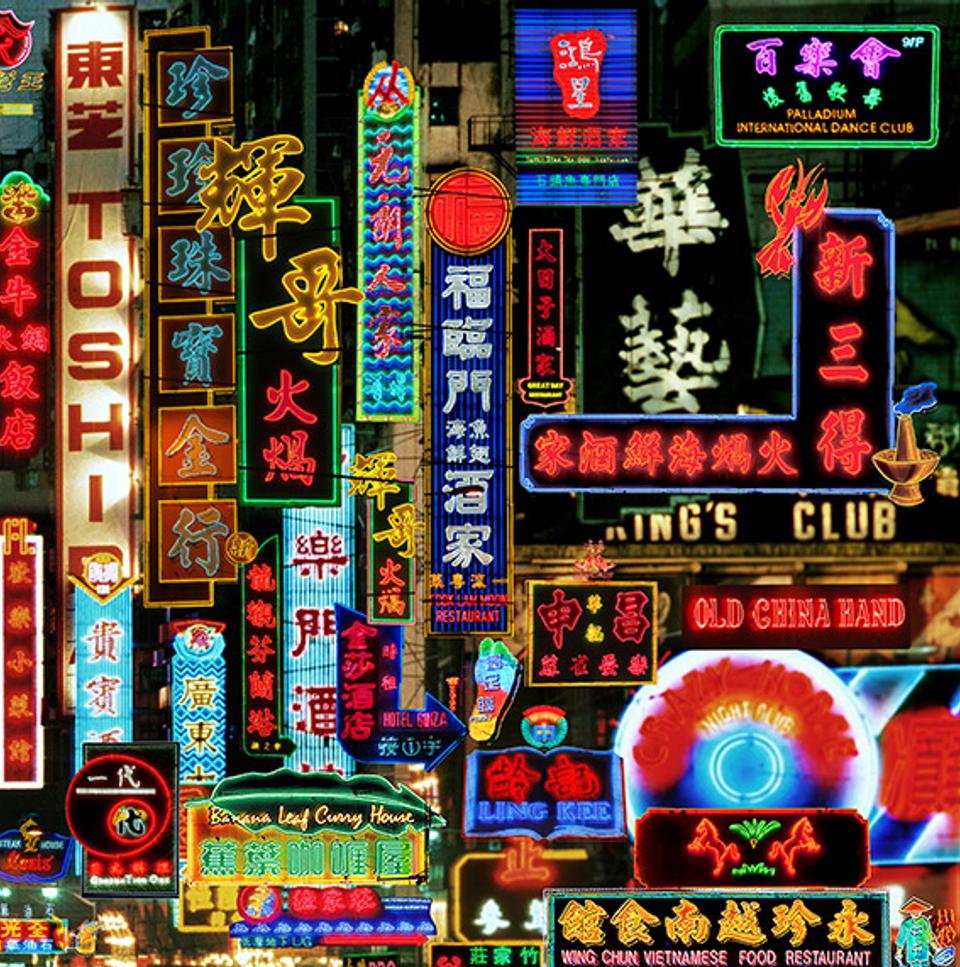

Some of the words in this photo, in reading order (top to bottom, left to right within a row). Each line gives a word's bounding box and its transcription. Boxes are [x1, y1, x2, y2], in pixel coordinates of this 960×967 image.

[66, 40, 124, 151] 東芝
[786, 108, 857, 120] PALLADIUM
[736, 121, 829, 134] INTERNATIONAL
[830, 121, 877, 134] DANCE
[879, 121, 915, 134] CLUB
[441, 263, 495, 414] 福臨門
[793, 501, 897, 541] CLUB
[435, 609, 500, 623] RESTAURANT
[692, 598, 746, 630] OLD
[751, 598, 832, 630] CHINA
[837, 598, 906, 630] HAND
[383, 711, 413, 727] HOTEL
[209, 805, 272, 826] Banana
[277, 804, 310, 831] Leaf
[313, 804, 364, 829] Curry
[369, 804, 416, 825] House
[477, 801, 549, 821] LING
[555, 801, 613, 821] KEE
[40, 840, 65, 849] HOUSE
[561, 950, 597, 967] WING
[601, 950, 640, 967] CHUN
[643, 950, 728, 967] VIETNAMESE
[738, 950, 777, 967] FOOD
[785, 950, 872, 967] RESTAURANT
